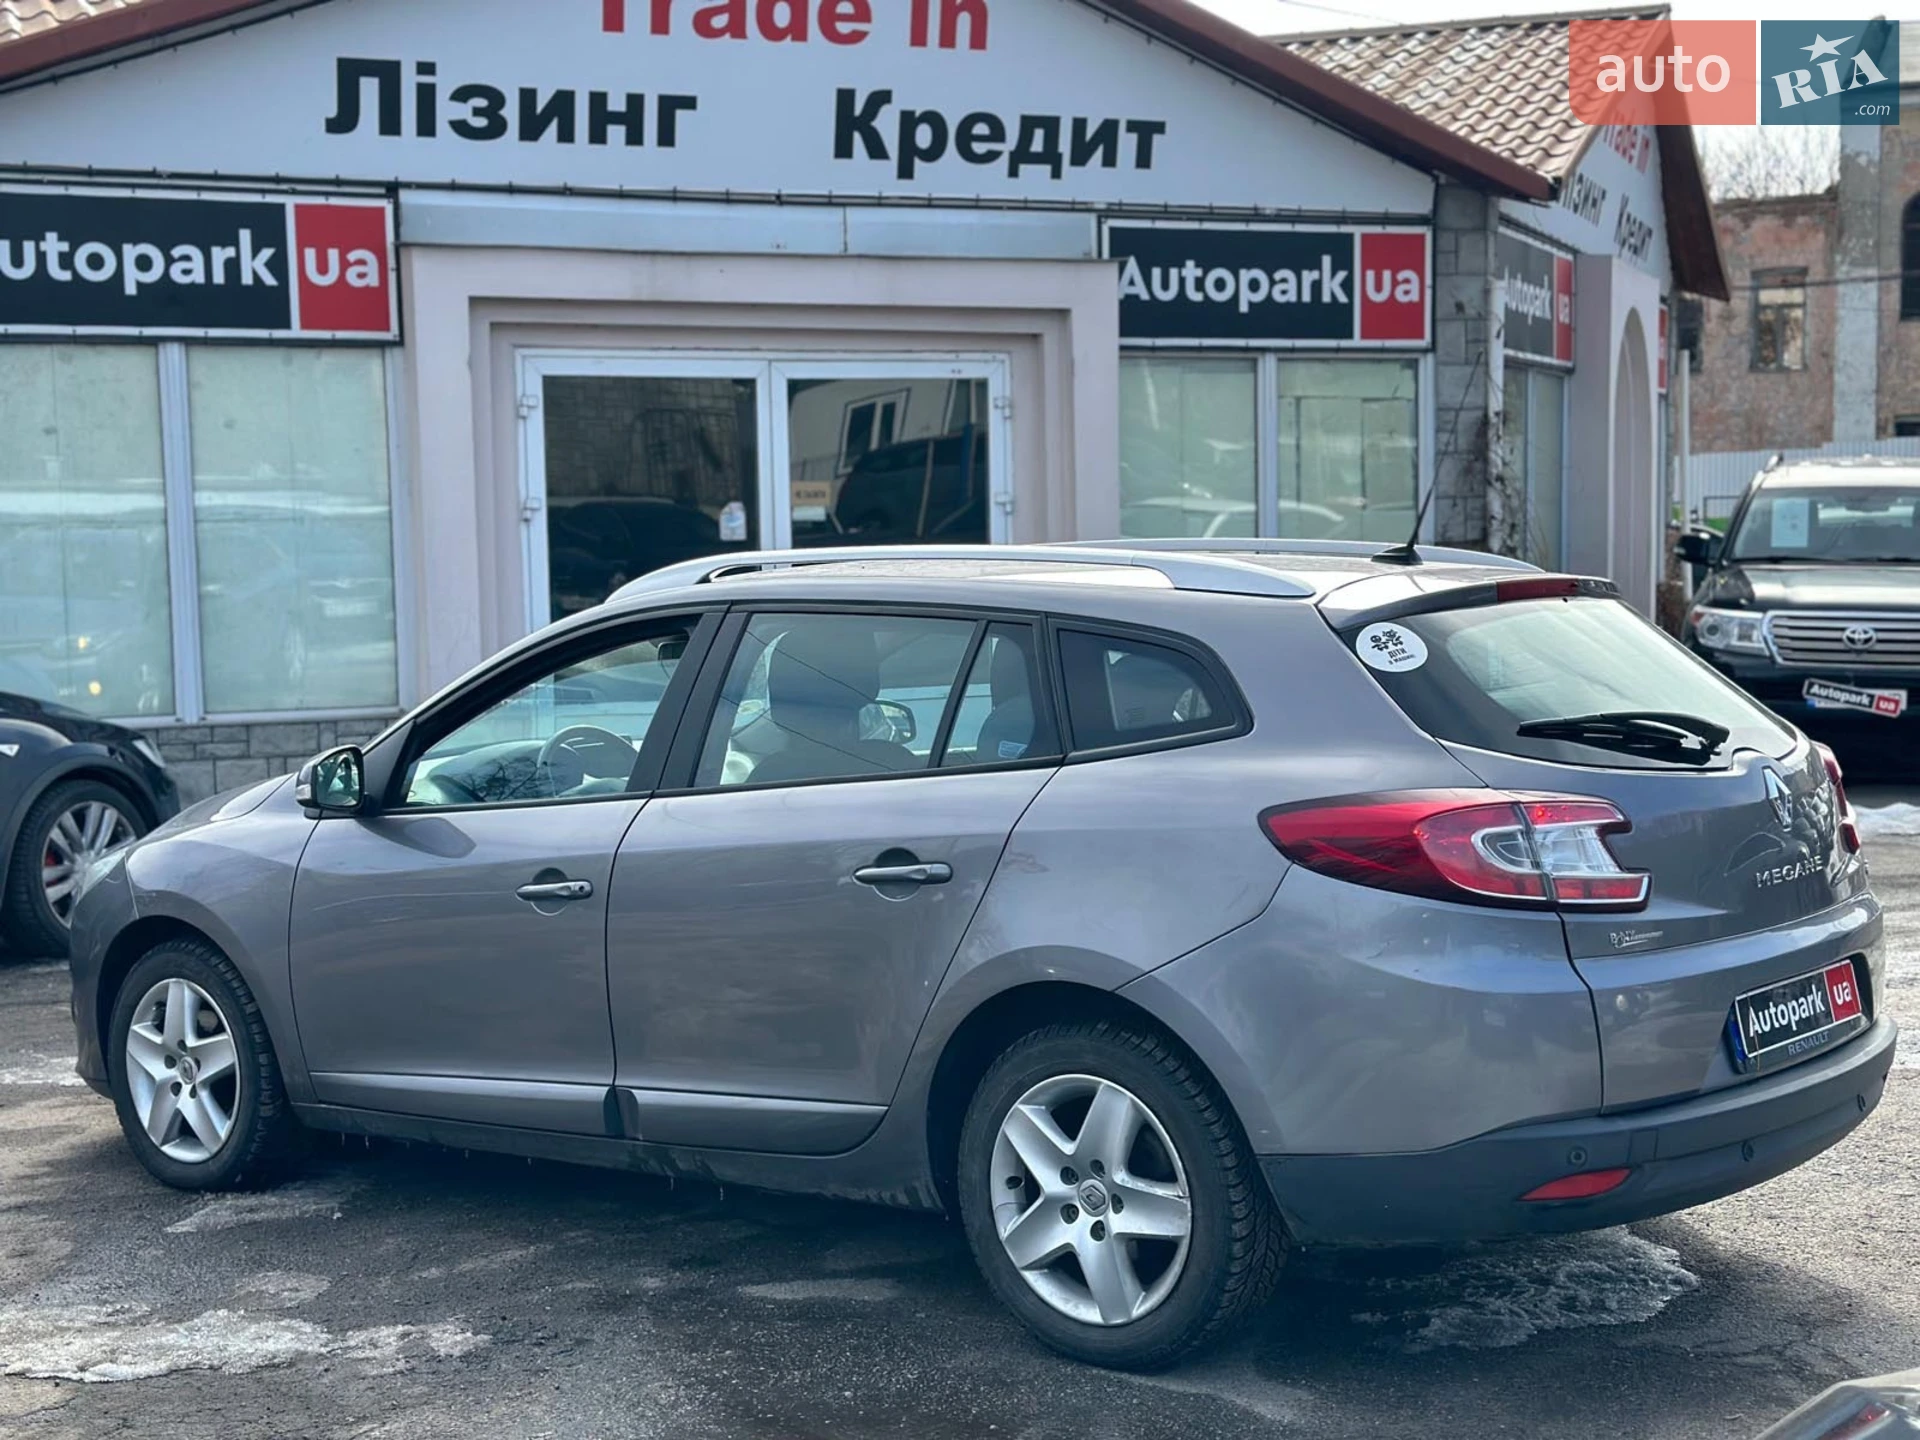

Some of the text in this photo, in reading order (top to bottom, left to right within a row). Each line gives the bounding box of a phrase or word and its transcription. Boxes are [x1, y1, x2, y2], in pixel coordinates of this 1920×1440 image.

[325, 57, 1166, 180] Лізинг Кредит
[0, 228, 380, 296] utopark ua
[1118, 254, 1420, 313] Autopark ua
[1810, 684, 1871, 706] Autopark
[1879, 700, 1896, 711] ua
[1755, 855, 1824, 888] MEGANE
[1749, 981, 1853, 1038] Autopark ua
[1787, 1030, 1831, 1056] RENAULT
